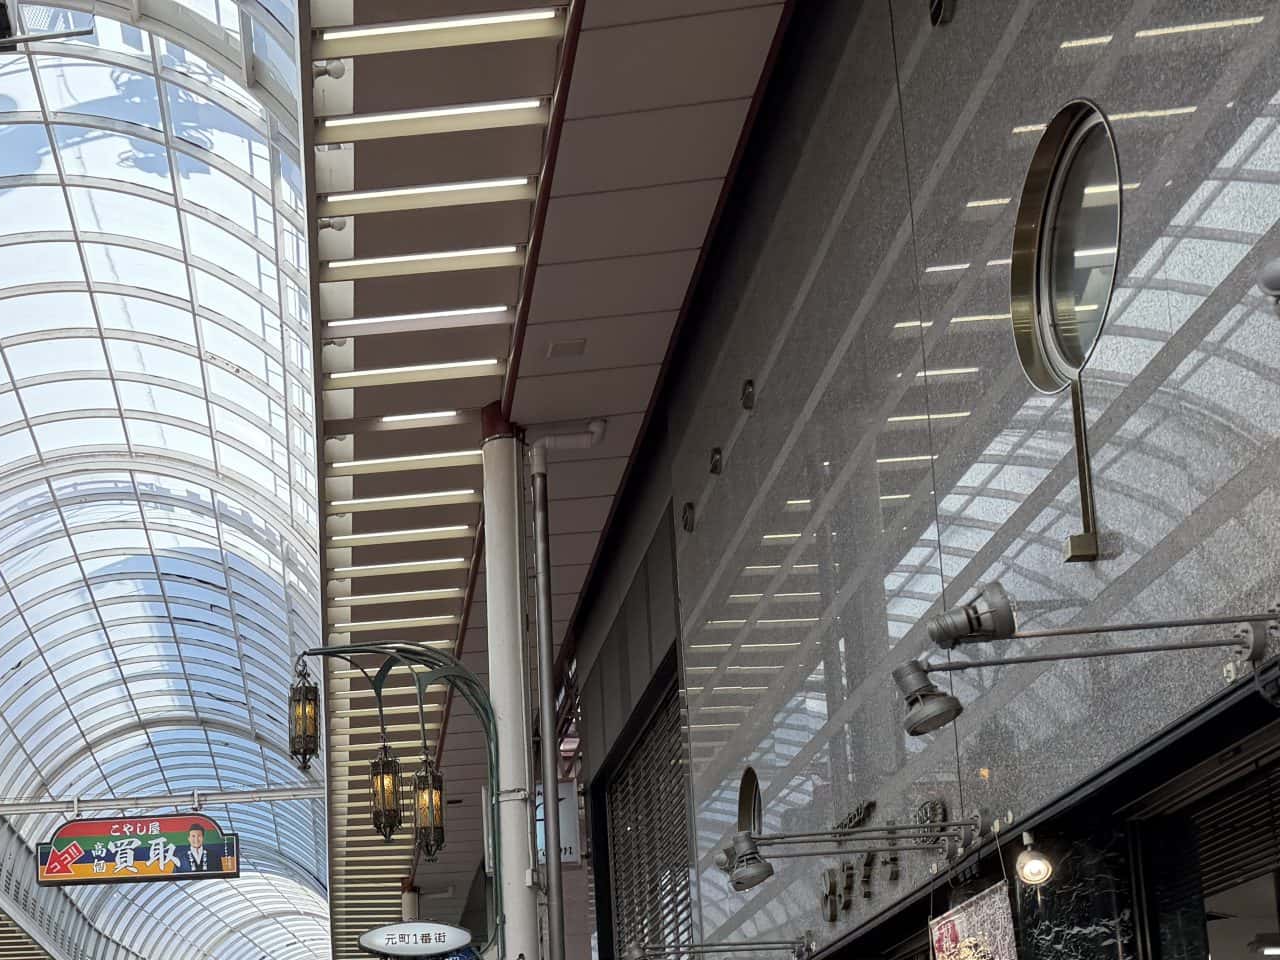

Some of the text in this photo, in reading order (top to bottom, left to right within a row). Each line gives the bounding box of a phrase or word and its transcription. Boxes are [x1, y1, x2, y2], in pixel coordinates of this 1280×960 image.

[110, 821, 161, 836] こやし屋
[91, 837, 181, 874] 高価 買取
[384, 931, 447, 945] 元町1番街
